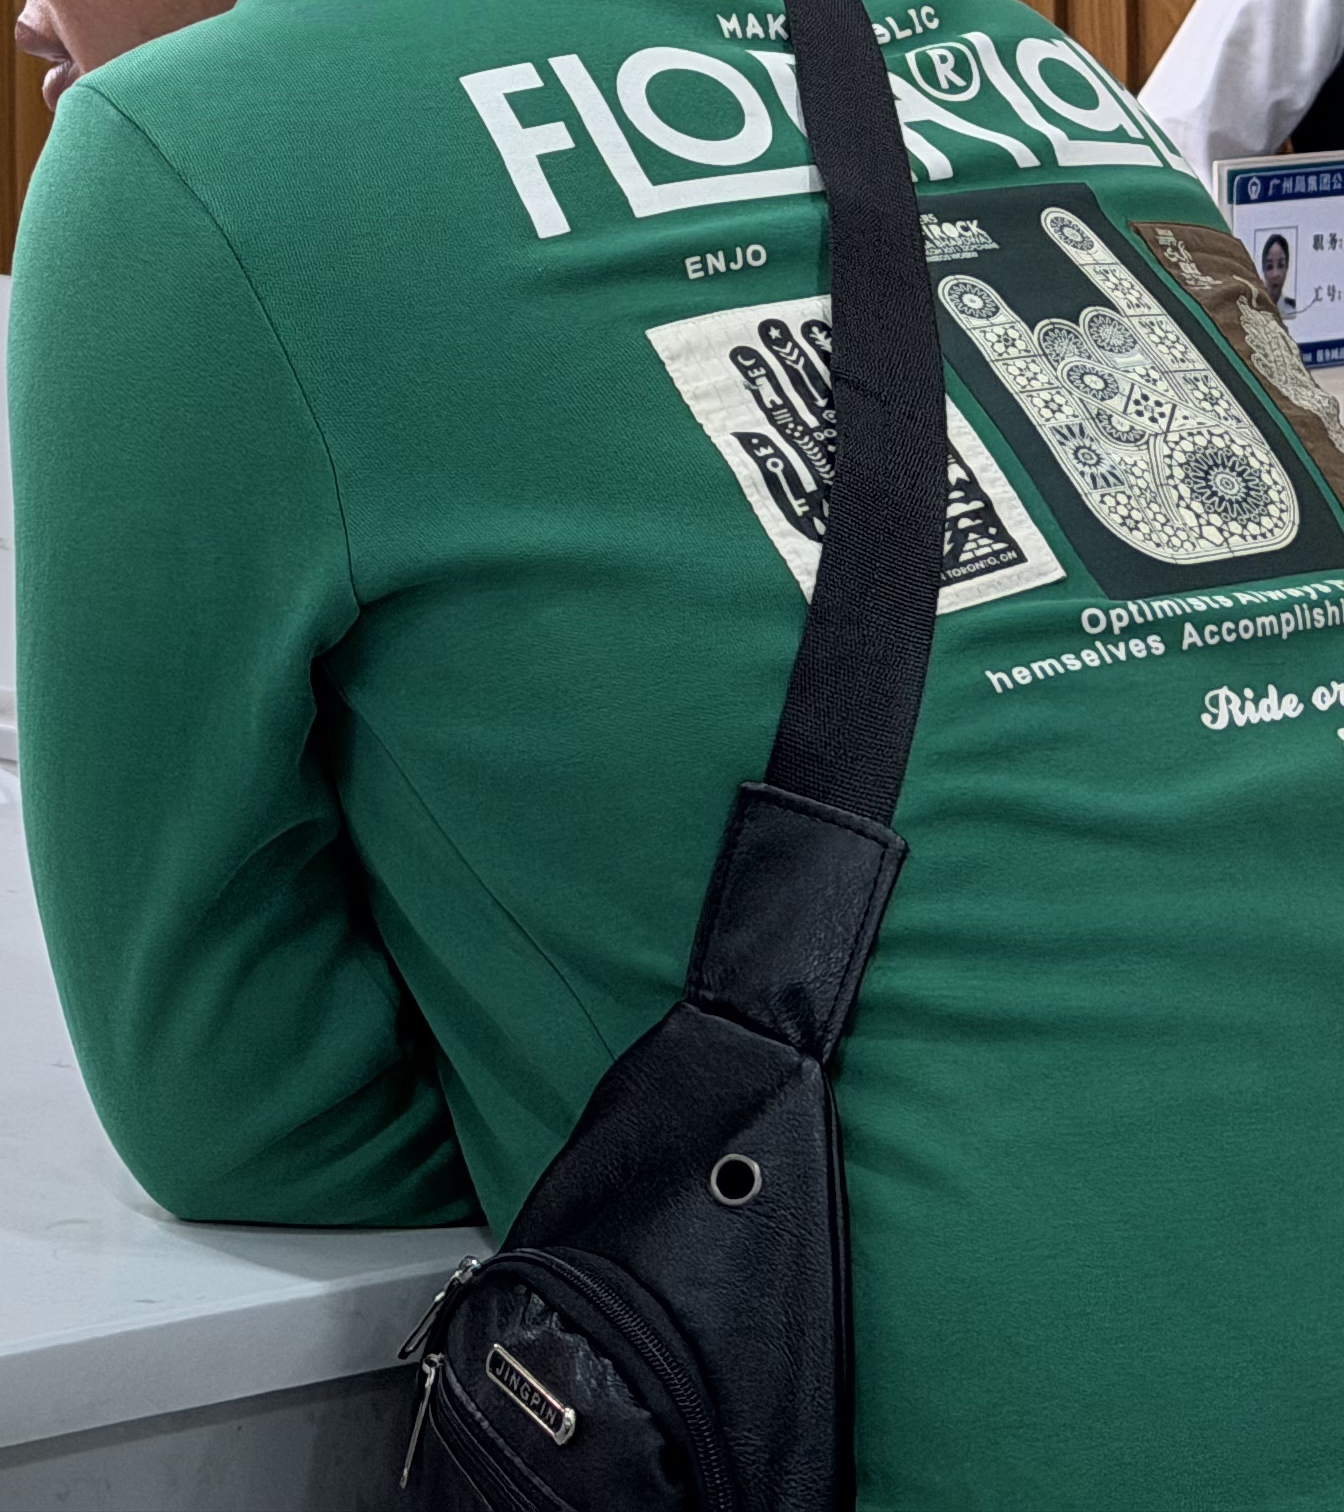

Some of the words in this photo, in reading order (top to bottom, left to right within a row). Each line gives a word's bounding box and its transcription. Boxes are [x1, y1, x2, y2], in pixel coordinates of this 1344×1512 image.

[716, 12, 789, 41] MAK
[684, 243, 768, 280] ENJO
[1081, 592, 1233, 636] Optimists
[985, 634, 1166, 694] hemselves
[1201, 683, 1306, 731] Ride
[495, 1360, 557, 1425] JINGPIN
